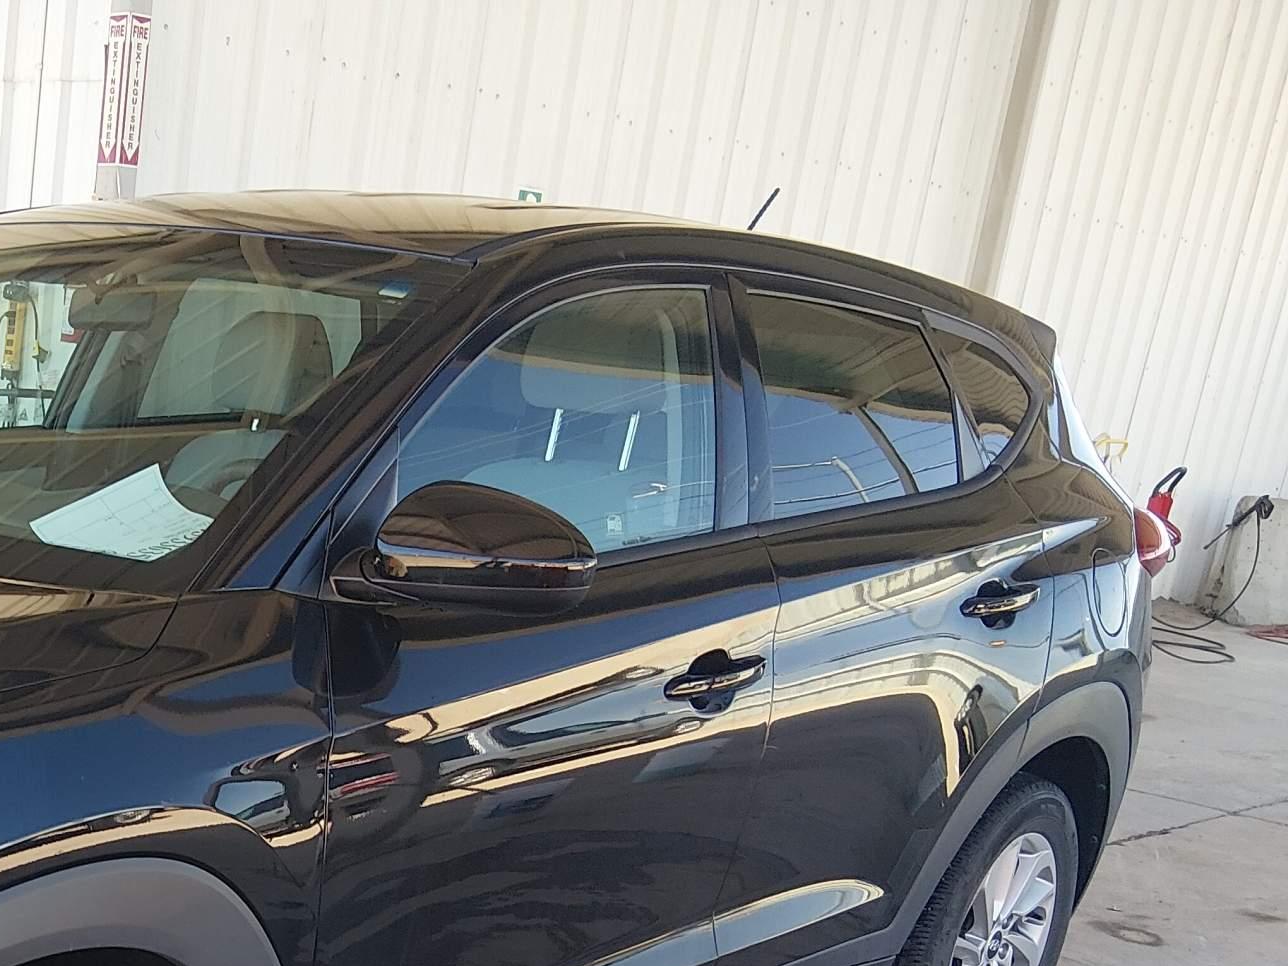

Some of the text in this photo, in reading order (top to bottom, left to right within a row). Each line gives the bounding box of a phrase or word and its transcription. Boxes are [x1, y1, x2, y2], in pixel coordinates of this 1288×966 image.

[110, 25, 125, 38] FIRE
[132, 25, 149, 40] FIRE
[104, 41, 119, 148] EXTINGUISHER
[127, 42, 143, 150] EXTINGUISHER
